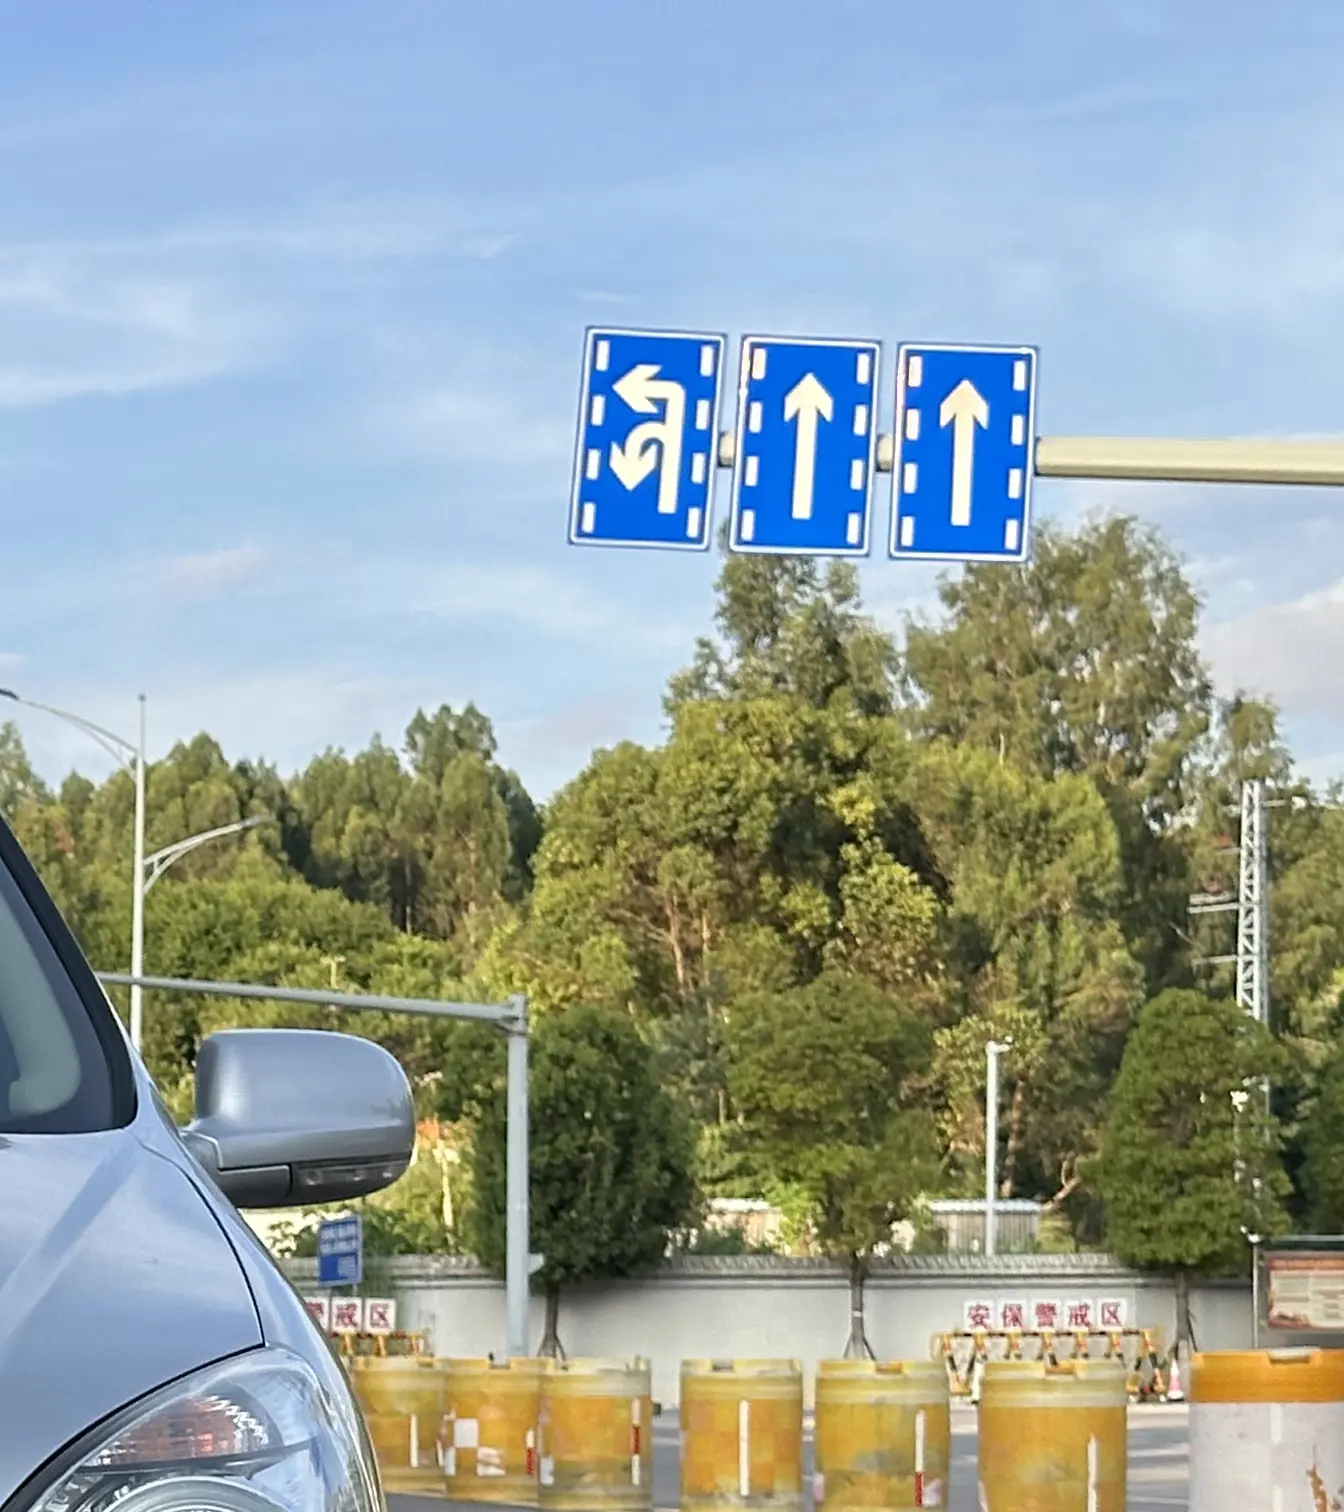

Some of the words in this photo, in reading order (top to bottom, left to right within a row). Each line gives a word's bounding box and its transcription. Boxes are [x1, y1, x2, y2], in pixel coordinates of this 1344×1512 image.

[967, 1302, 1122, 1328] 安保警戒区
